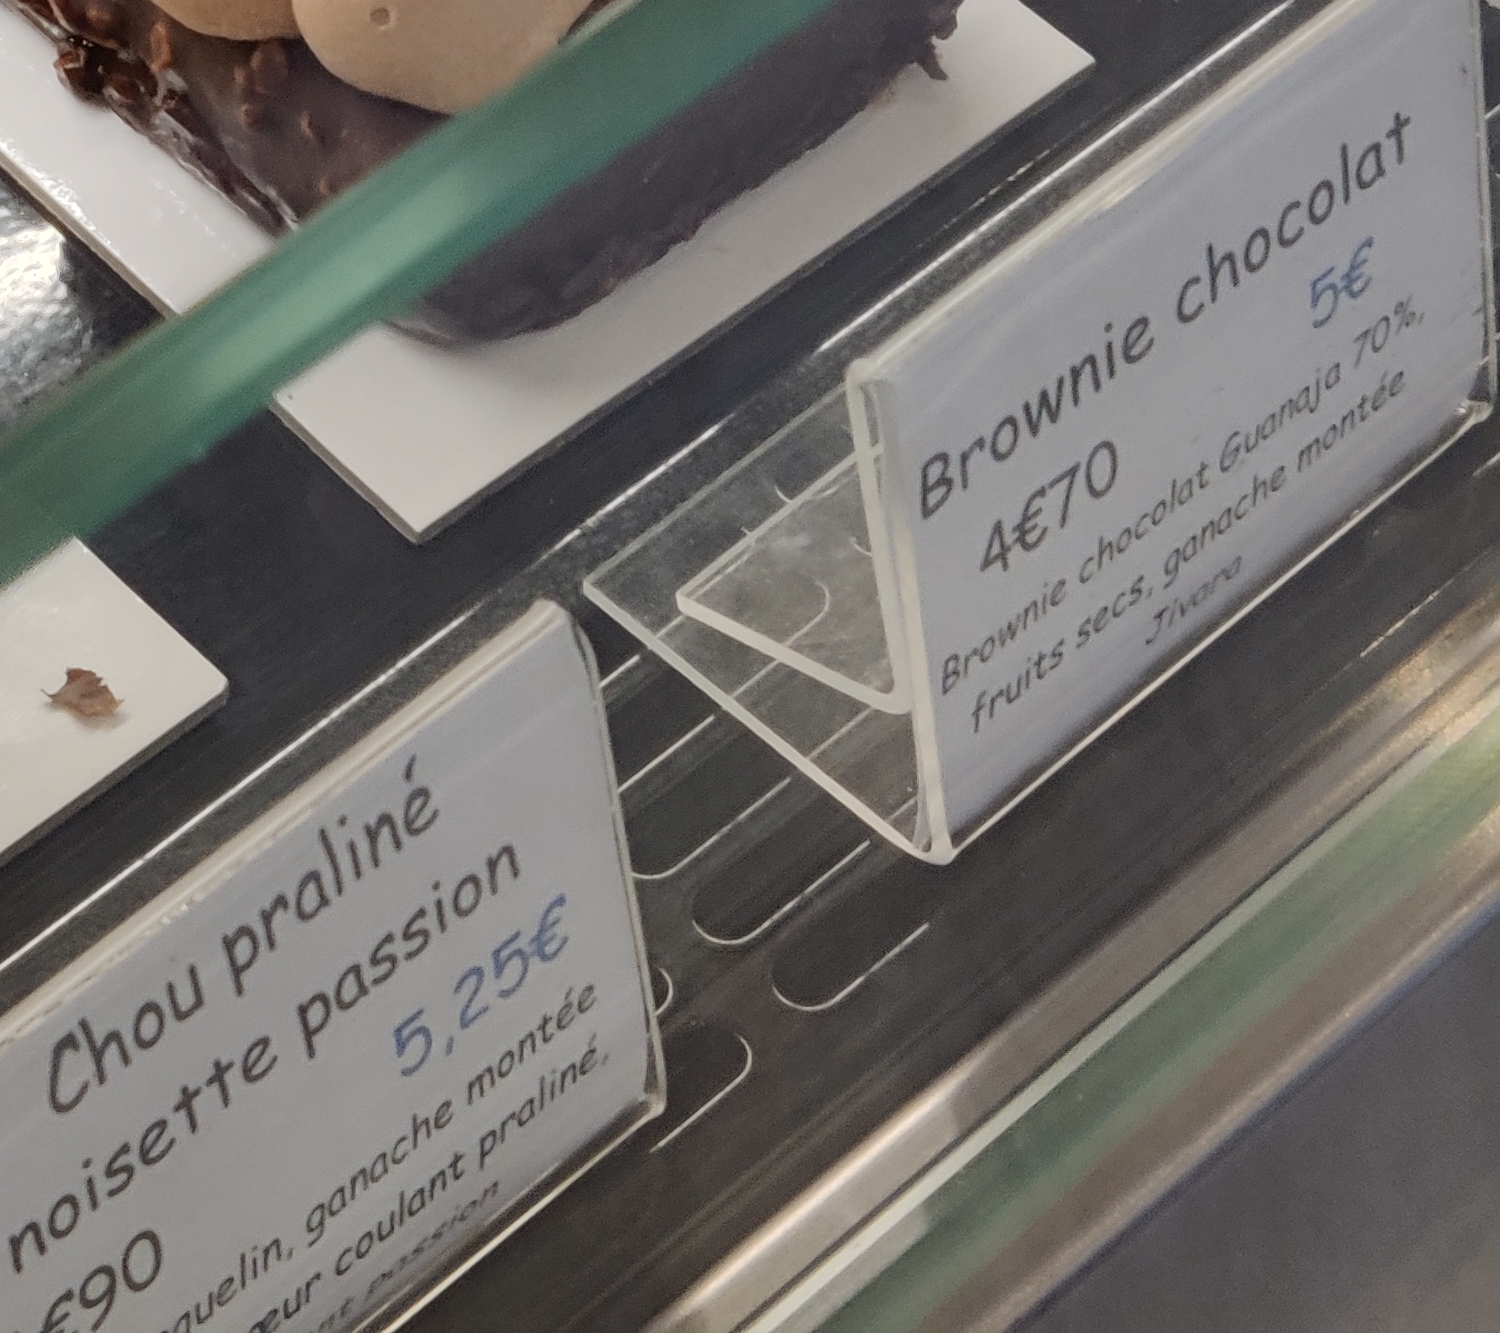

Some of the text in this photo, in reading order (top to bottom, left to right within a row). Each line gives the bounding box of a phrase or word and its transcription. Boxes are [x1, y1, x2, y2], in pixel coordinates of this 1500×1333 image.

[920, 112, 1411, 520] Brownie chocolat
[1310, 235, 1375, 329] 5€
[942, 578, 1067, 696] Brownie
[1079, 461, 1209, 584] chocolat
[1219, 362, 1341, 473] Guanaja
[972, 638, 1065, 733] fruits
[1163, 465, 1286, 589] ganache
[1298, 369, 1405, 473] montée
[980, 440, 1118, 572] 4€70
[1145, 555, 1243, 645] Jivara
[48, 753, 439, 1114] Chou praliné
[393, 892, 569, 1077] 5,25€
[8, 842, 520, 1274] noisette passion
[305, 1098, 454, 1247] ganache
[467, 984, 597, 1106] montée
[36, 1229, 162, 1333] €90
[334, 1150, 465, 1276] coulant
